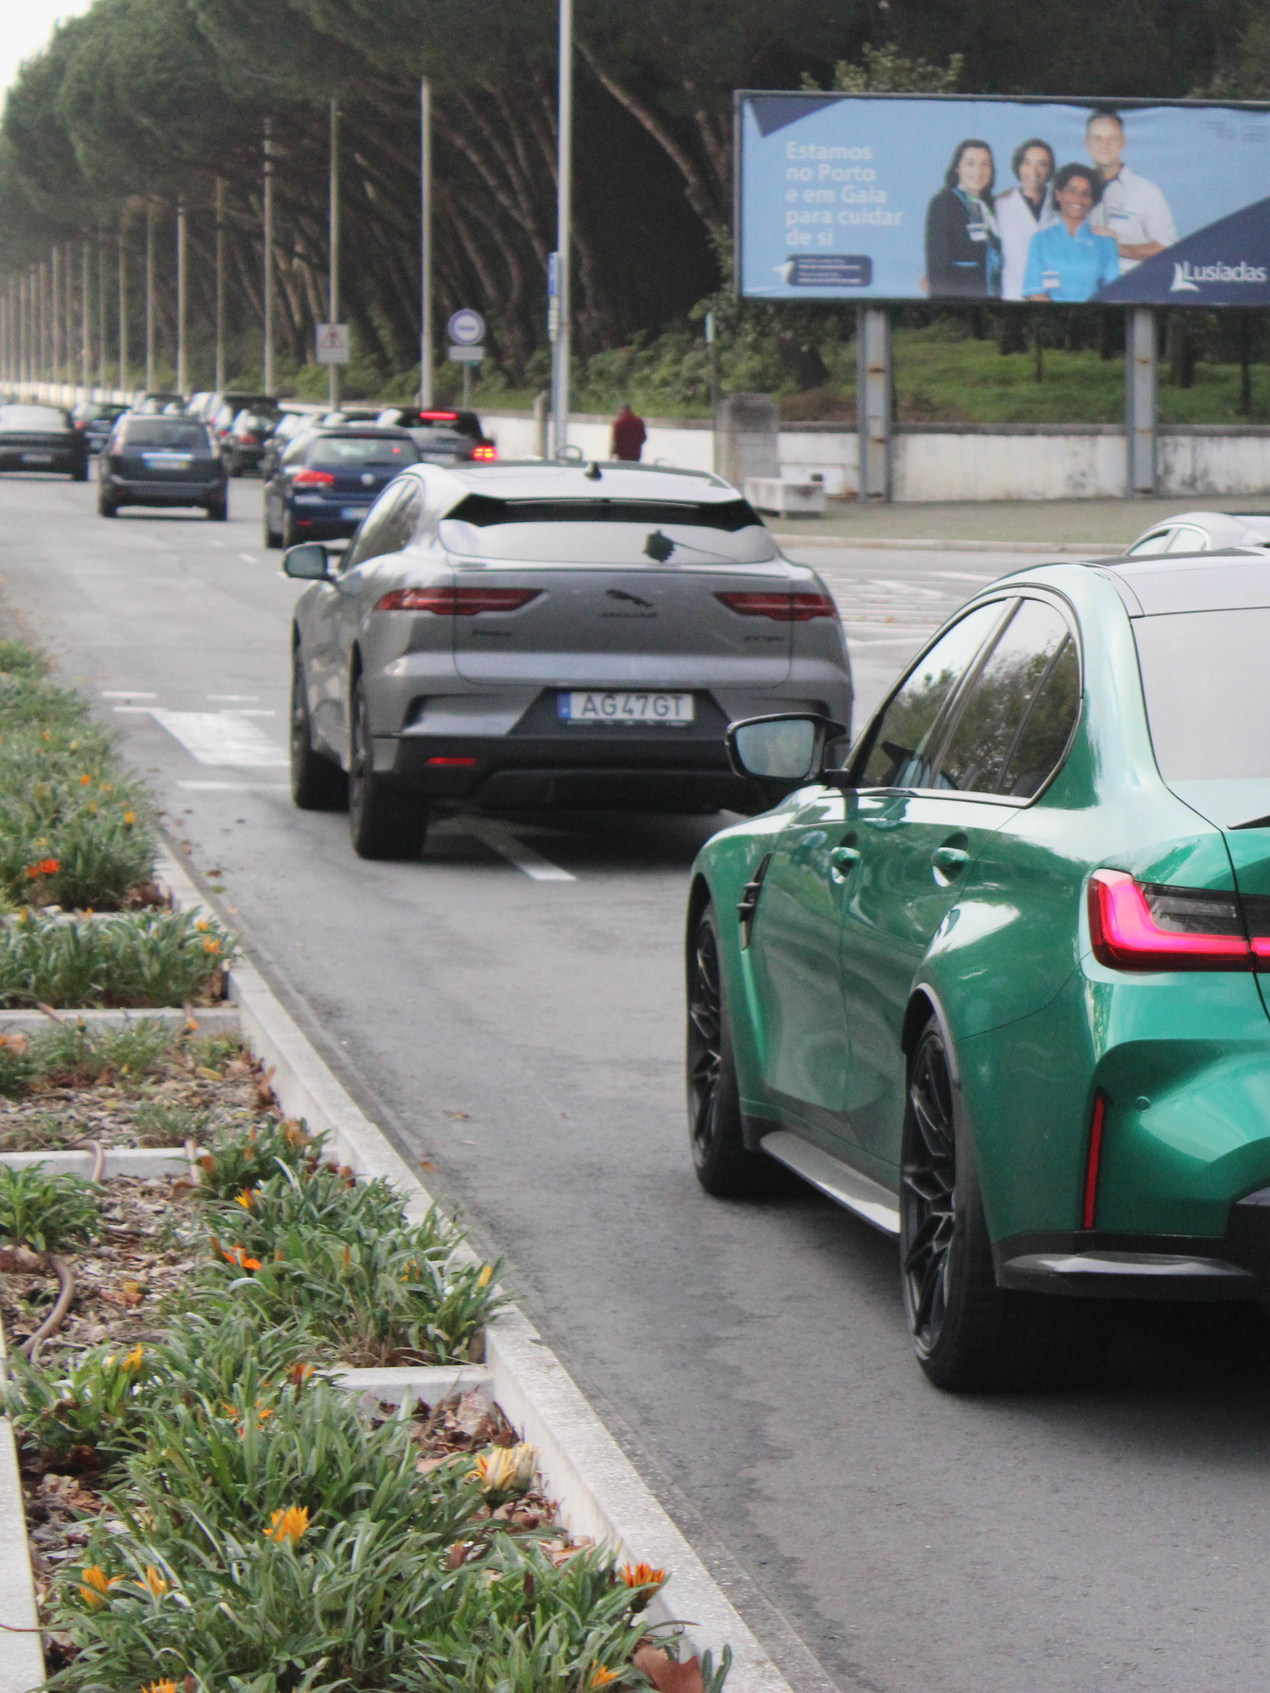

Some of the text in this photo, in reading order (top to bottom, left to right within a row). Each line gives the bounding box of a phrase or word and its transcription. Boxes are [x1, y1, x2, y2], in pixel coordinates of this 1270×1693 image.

[786, 142, 873, 160] Estamos
[786, 164, 877, 182] no Porto
[786, 185, 888, 203] e em Gaia
[786, 207, 903, 227] para cuidar
[786, 229, 834, 245] de si
[581, 694, 686, 717] AG47GT
